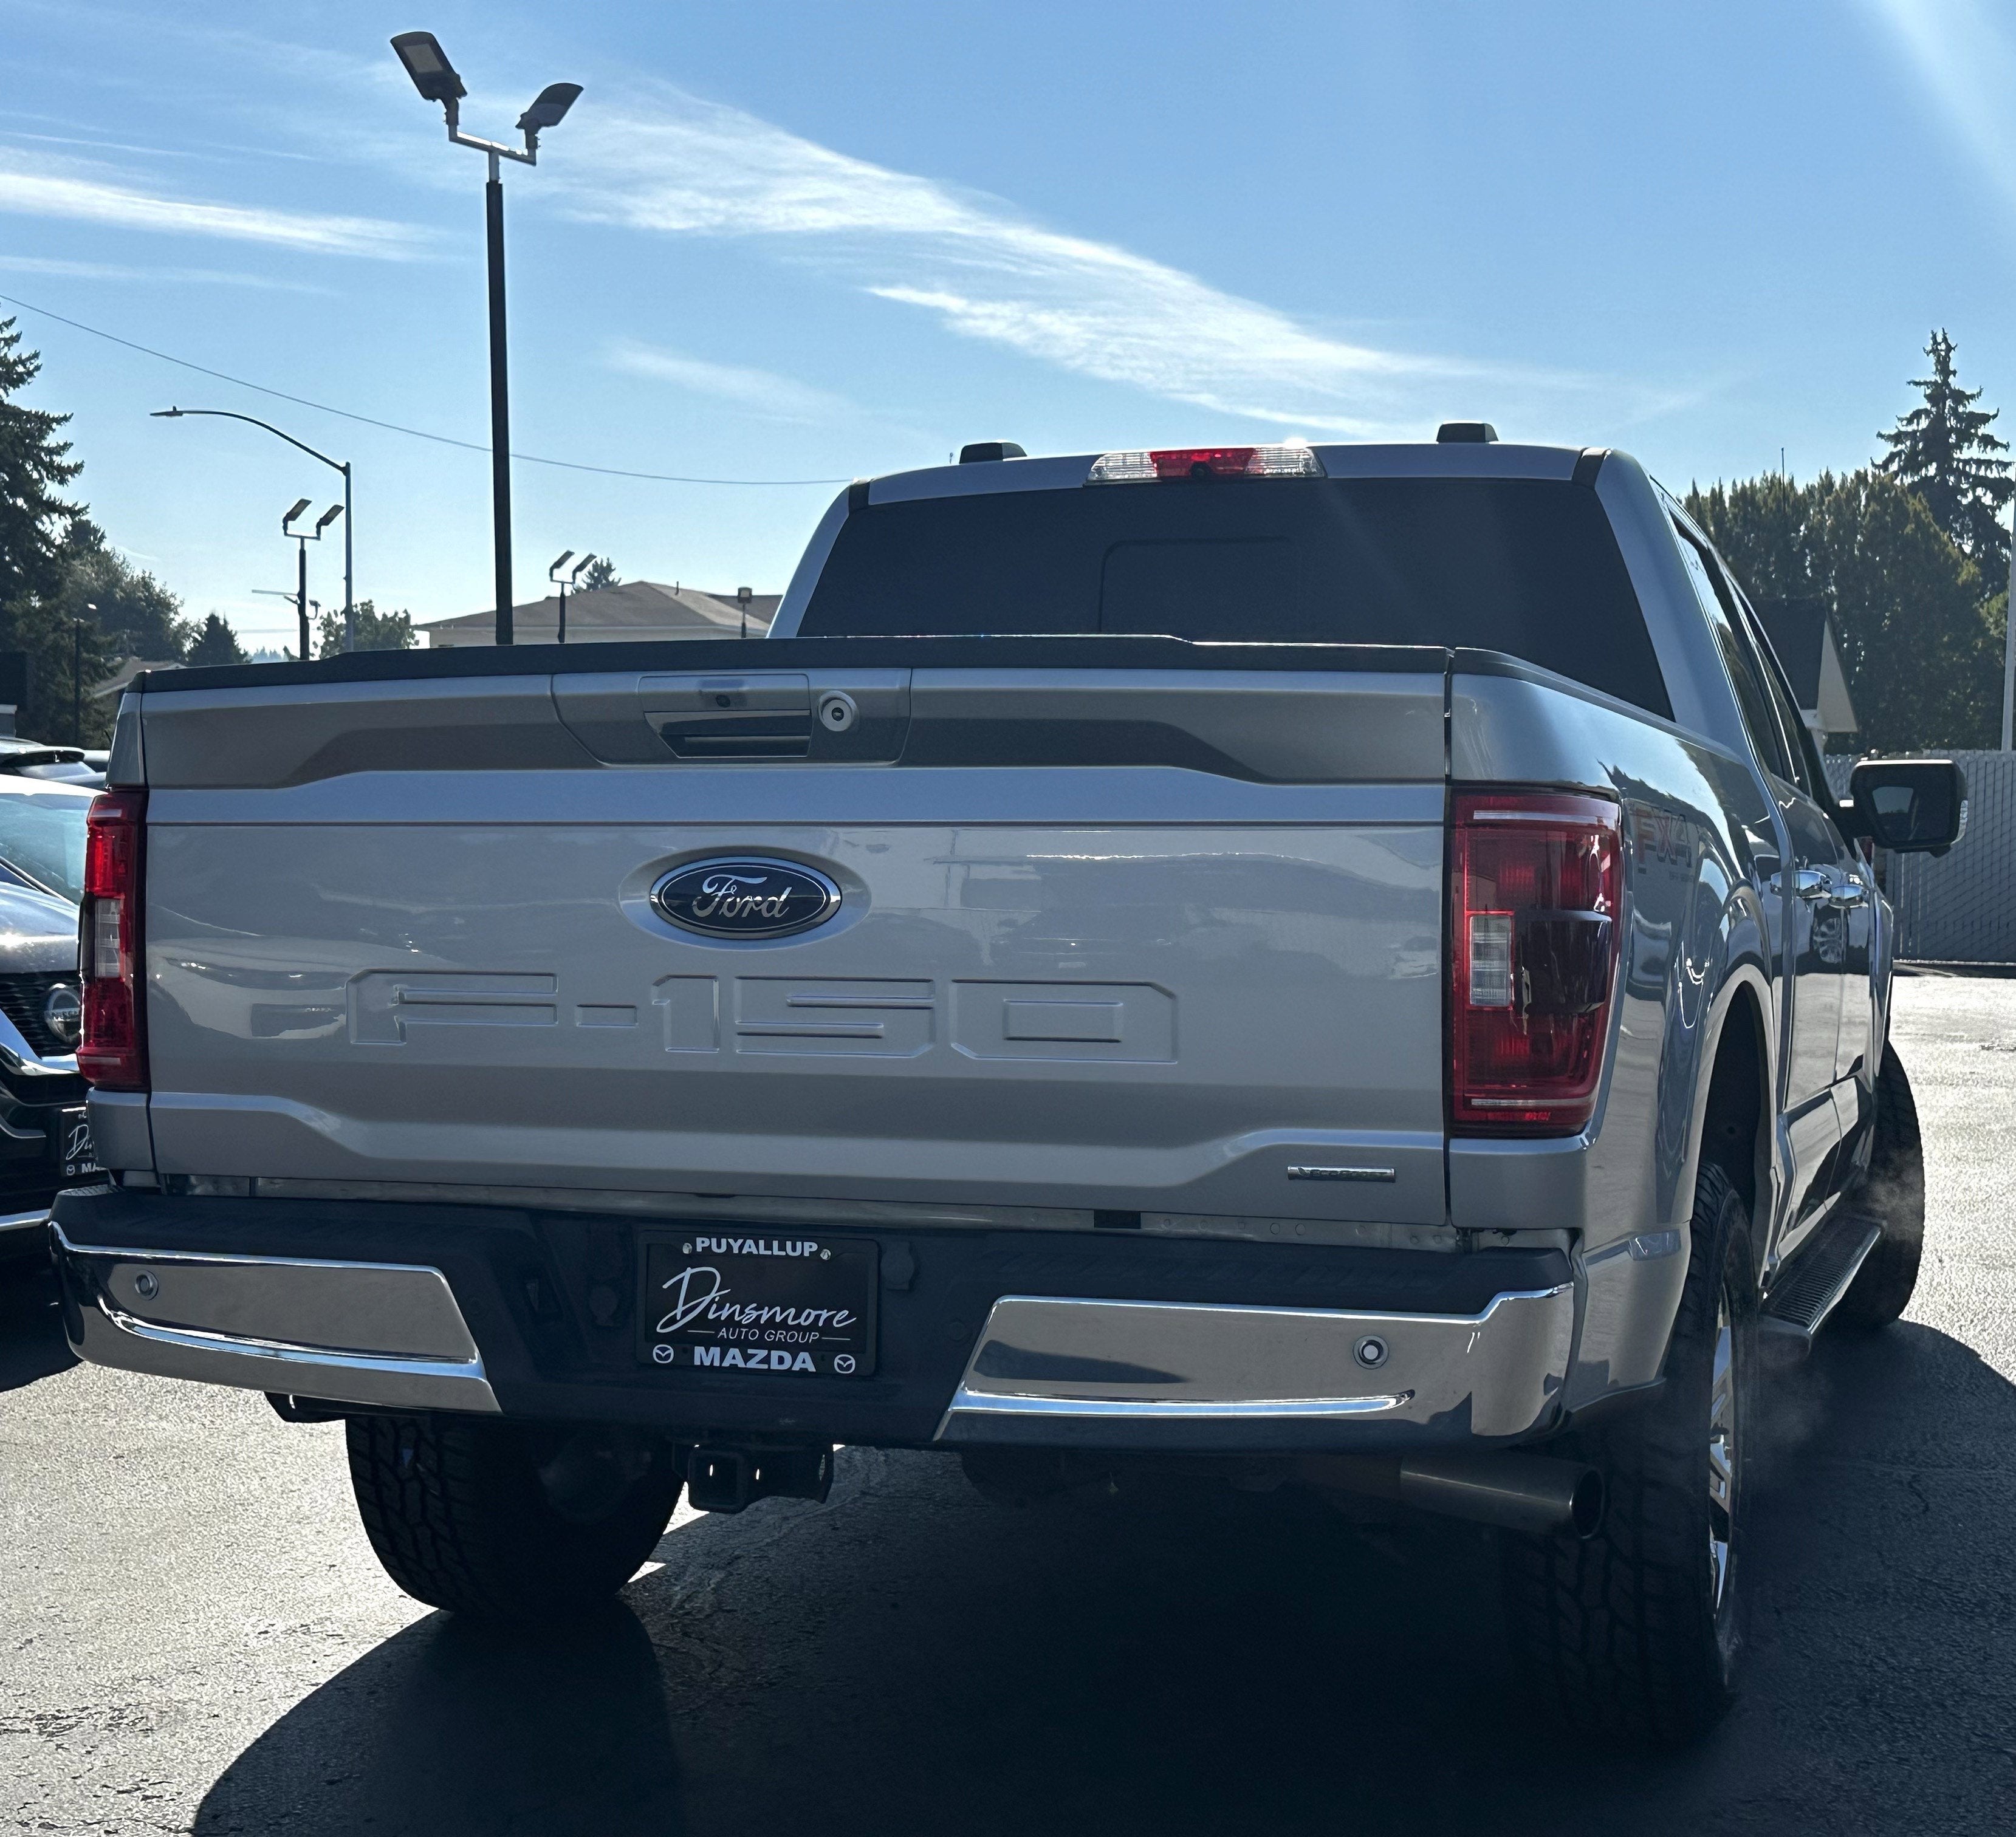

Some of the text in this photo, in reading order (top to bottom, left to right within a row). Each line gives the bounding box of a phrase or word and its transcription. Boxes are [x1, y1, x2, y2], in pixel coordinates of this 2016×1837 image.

[1634, 807, 1692, 874] FX4
[692, 874, 792, 918] Ford
[345, 968, 1178, 1064] F-150
[696, 1237, 818, 1257] PUYALLUP
[656, 1266, 857, 1333] Dinsmore
[718, 1327, 820, 1343] AUTO GROUP
[694, 1346, 817, 1372] MAZDA
